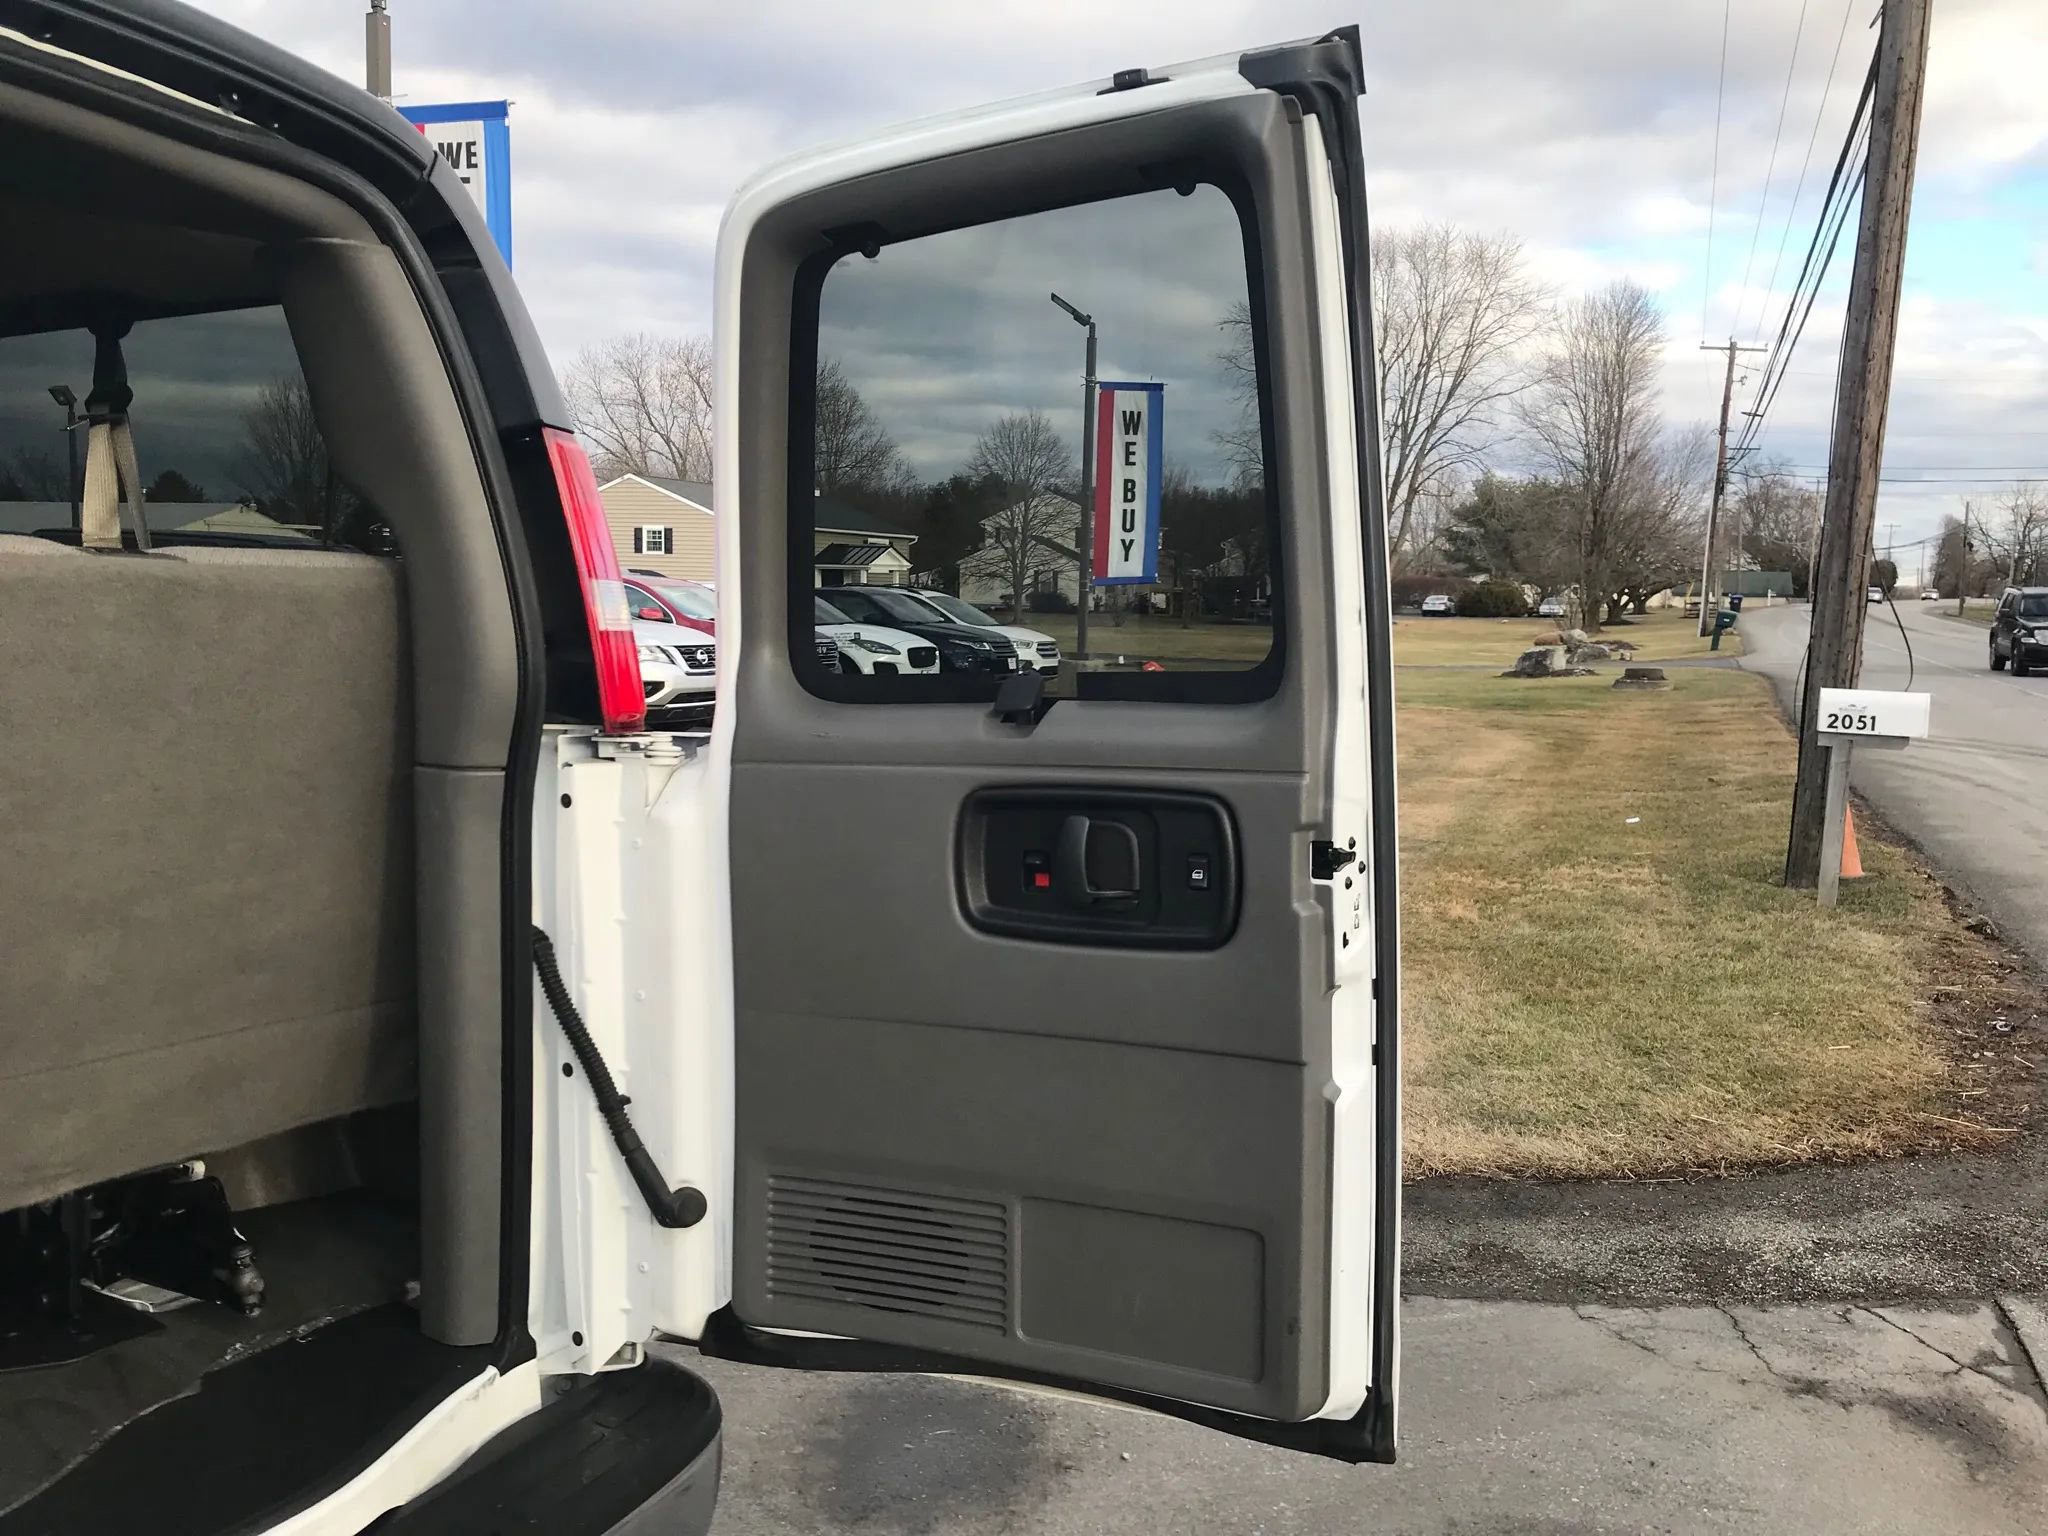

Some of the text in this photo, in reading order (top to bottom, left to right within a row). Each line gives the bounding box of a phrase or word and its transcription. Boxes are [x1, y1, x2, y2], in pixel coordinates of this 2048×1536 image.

[1120, 410, 1142, 563] WE BUY
[1826, 713, 1877, 732] 2051
